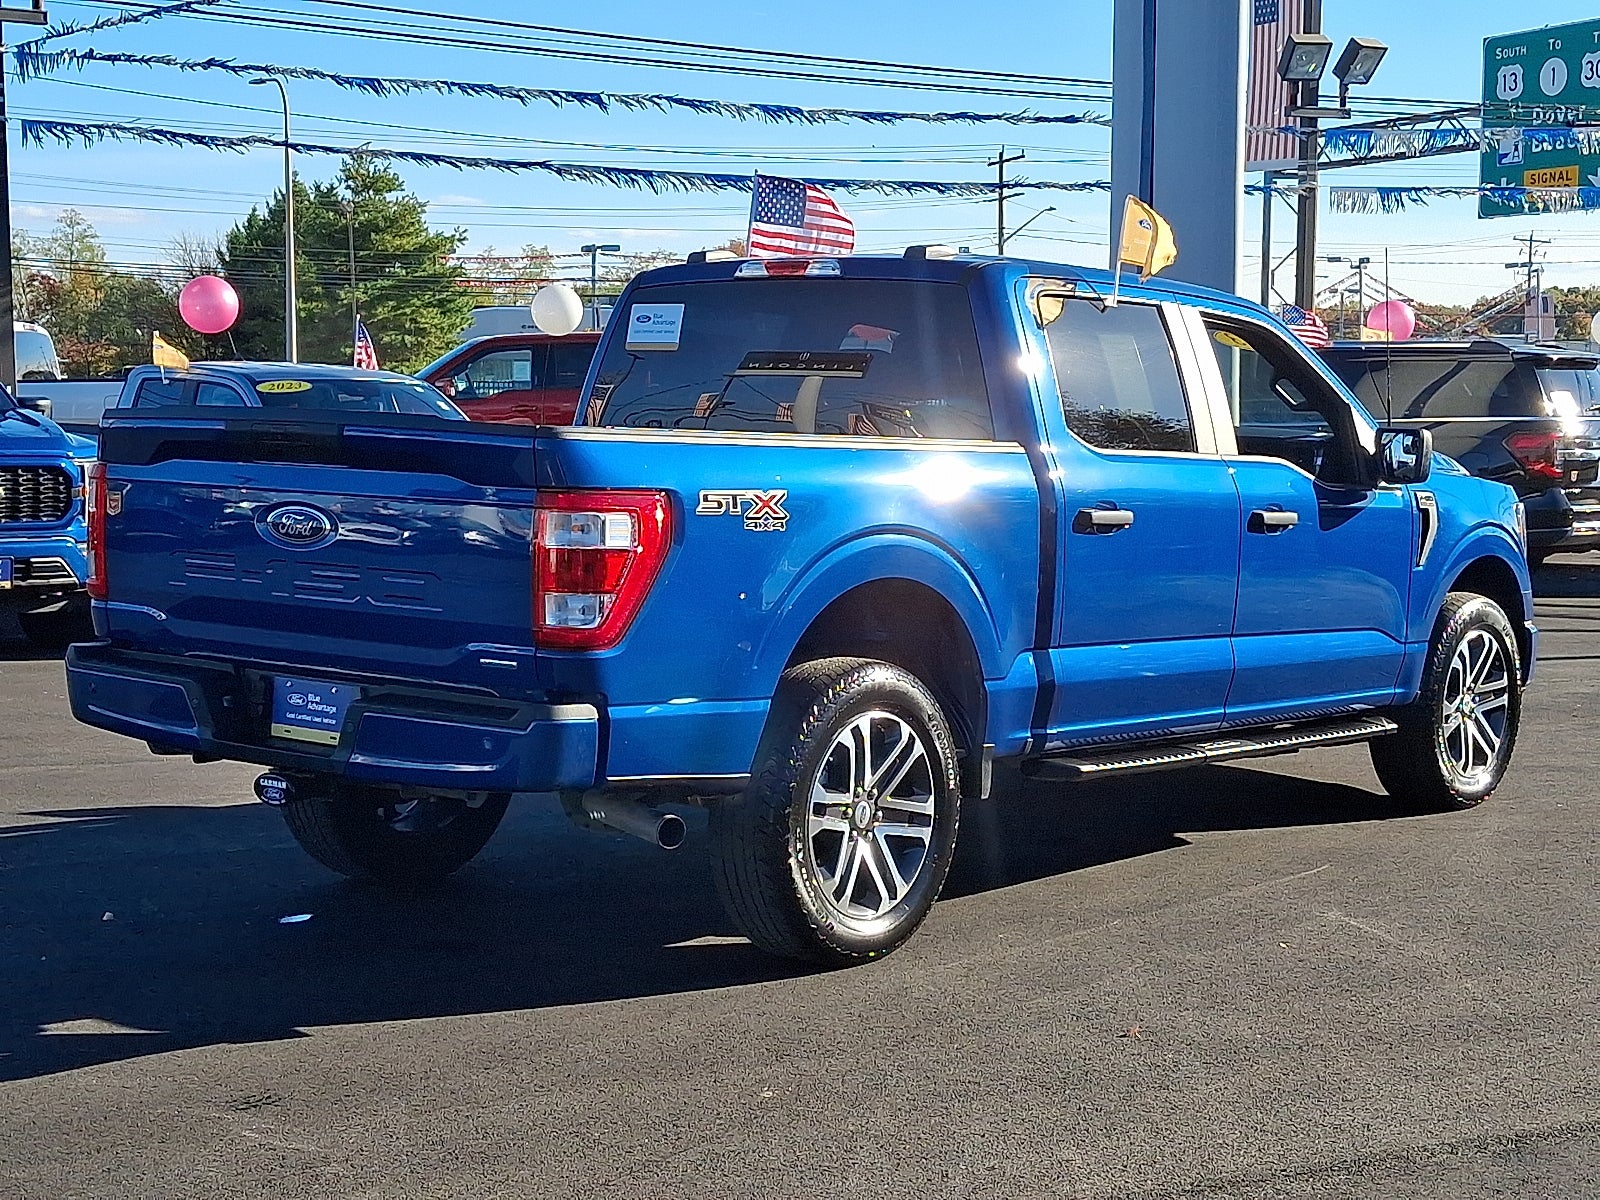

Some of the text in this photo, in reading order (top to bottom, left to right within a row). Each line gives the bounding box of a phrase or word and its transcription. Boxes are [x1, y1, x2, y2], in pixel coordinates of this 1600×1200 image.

[1584, 60, 1600, 81] 30
[1502, 71, 1518, 93] 13
[1530, 170, 1573, 185] SIGNAL
[268, 382, 302, 391] 2023
[696, 489, 790, 521] STX
[278, 513, 313, 536] Ford
[307, 693, 321, 702] Blue
